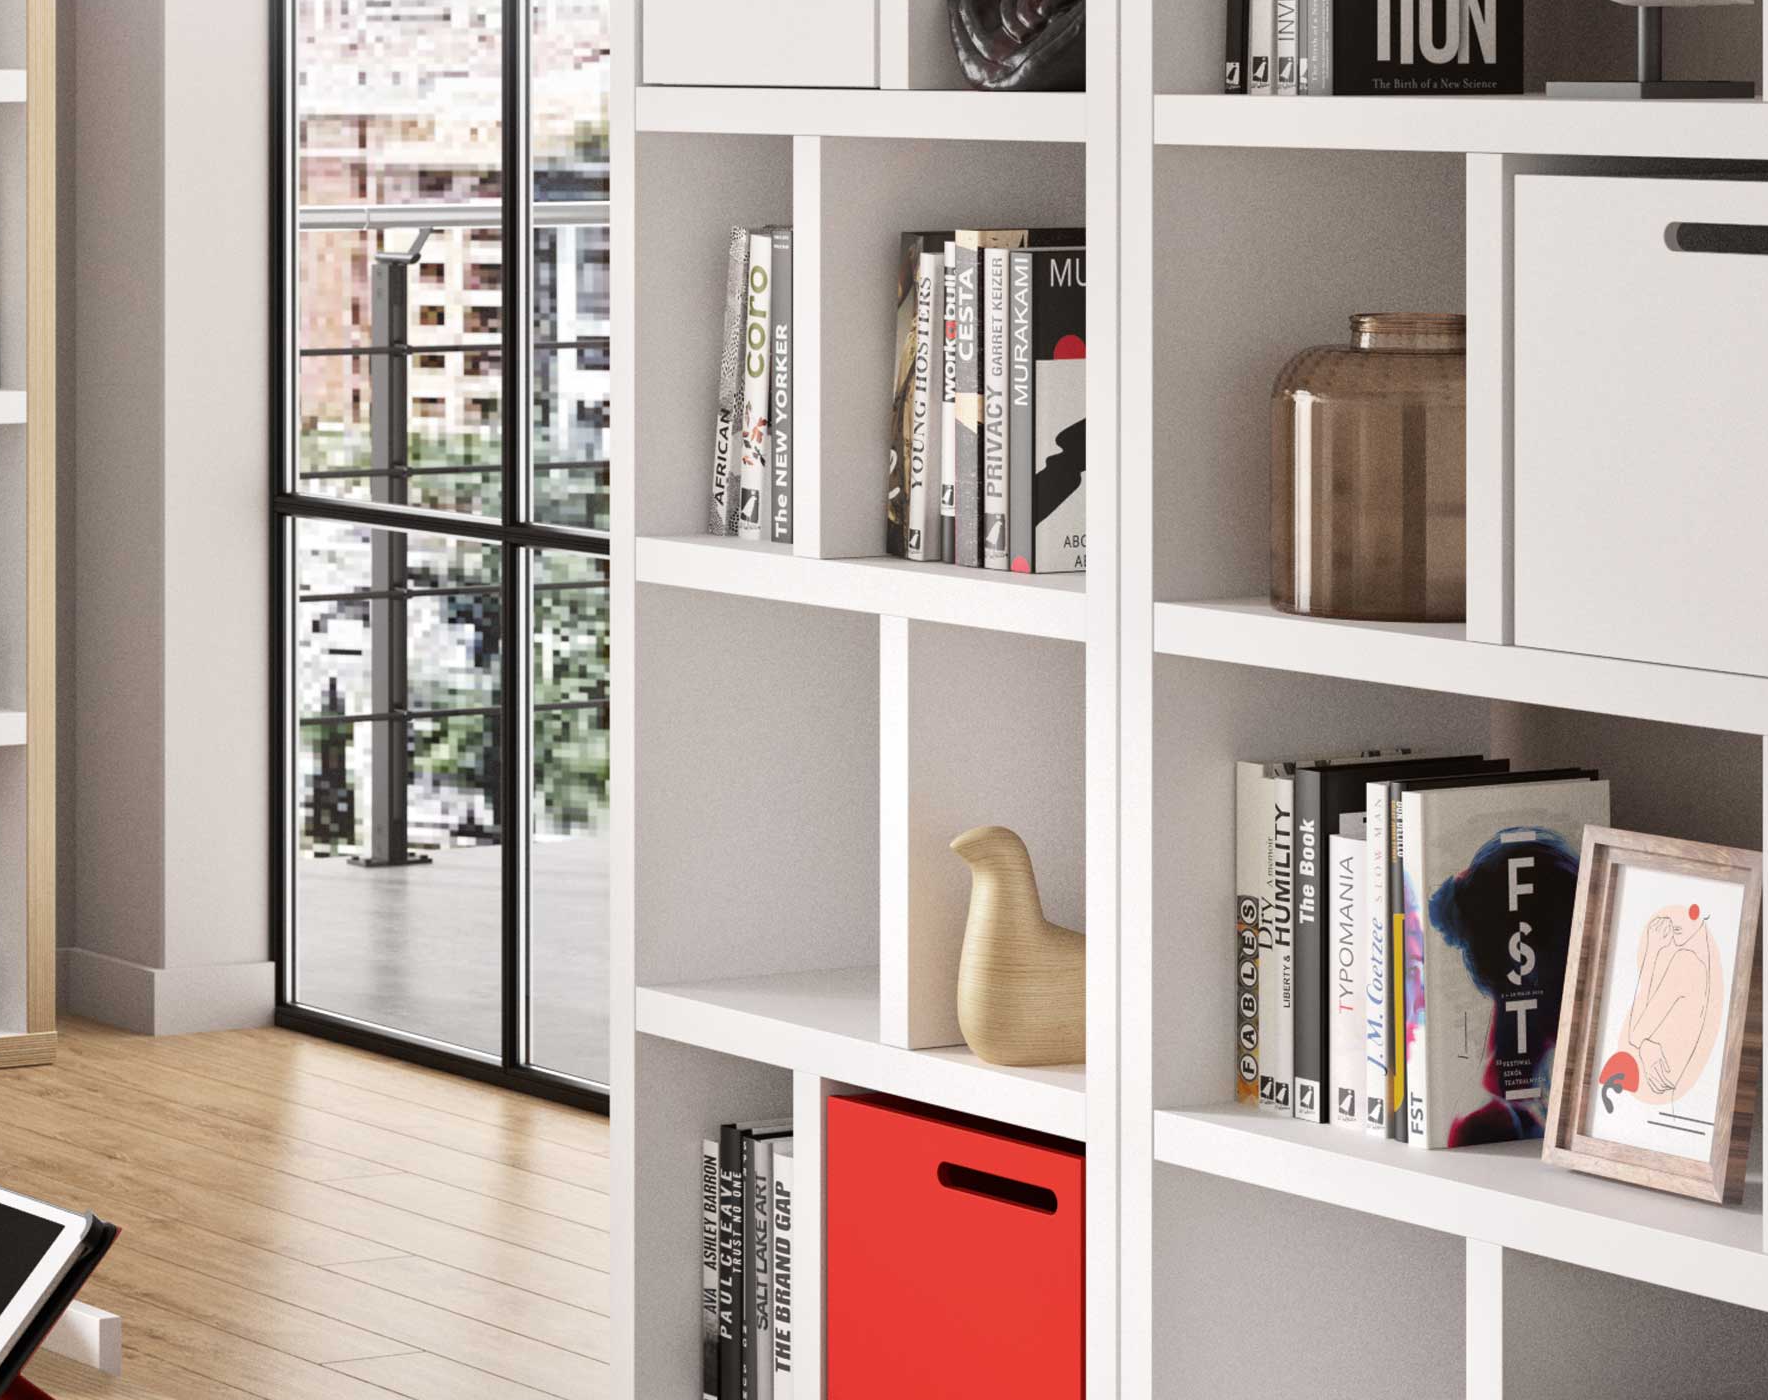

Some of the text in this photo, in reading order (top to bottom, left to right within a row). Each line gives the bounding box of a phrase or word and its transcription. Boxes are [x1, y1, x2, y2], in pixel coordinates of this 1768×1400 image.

[1371, 78, 1391, 89] The
[1393, 78, 1417, 89] Birth
[1420, 78, 1430, 89] of
[1440, 78, 1459, 89] New
[1462, 78, 1498, 89] Science
[747, 265, 768, 378] coro
[912, 276, 932, 489] YOUNG HOSTERS
[958, 267, 974, 361] CESTA
[987, 257, 1003, 498] PRIVACY GARRET KEIZER
[1014, 257, 1029, 406] MURAKAMI
[715, 408, 731, 506] AFRICAN
[775, 324, 788, 538] The NEW YORKER
[1275, 802, 1291, 1008] LIBERTY & HUMILITY
[1299, 819, 1315, 924] The Book
[1339, 855, 1353, 1013] TYPOMANIA
[1411, 1094, 1424, 1136] FST
[704, 1155, 717, 1315] AVA ASHLEY BARRON
[720, 1168, 733, 1340] PAUL CLEAVE
[733, 1171, 742, 1274] TRUST NO ONE
[755, 1175, 768, 1331] SALT LAKE ART
[775, 1181, 791, 1373] THE BRAND GAP
